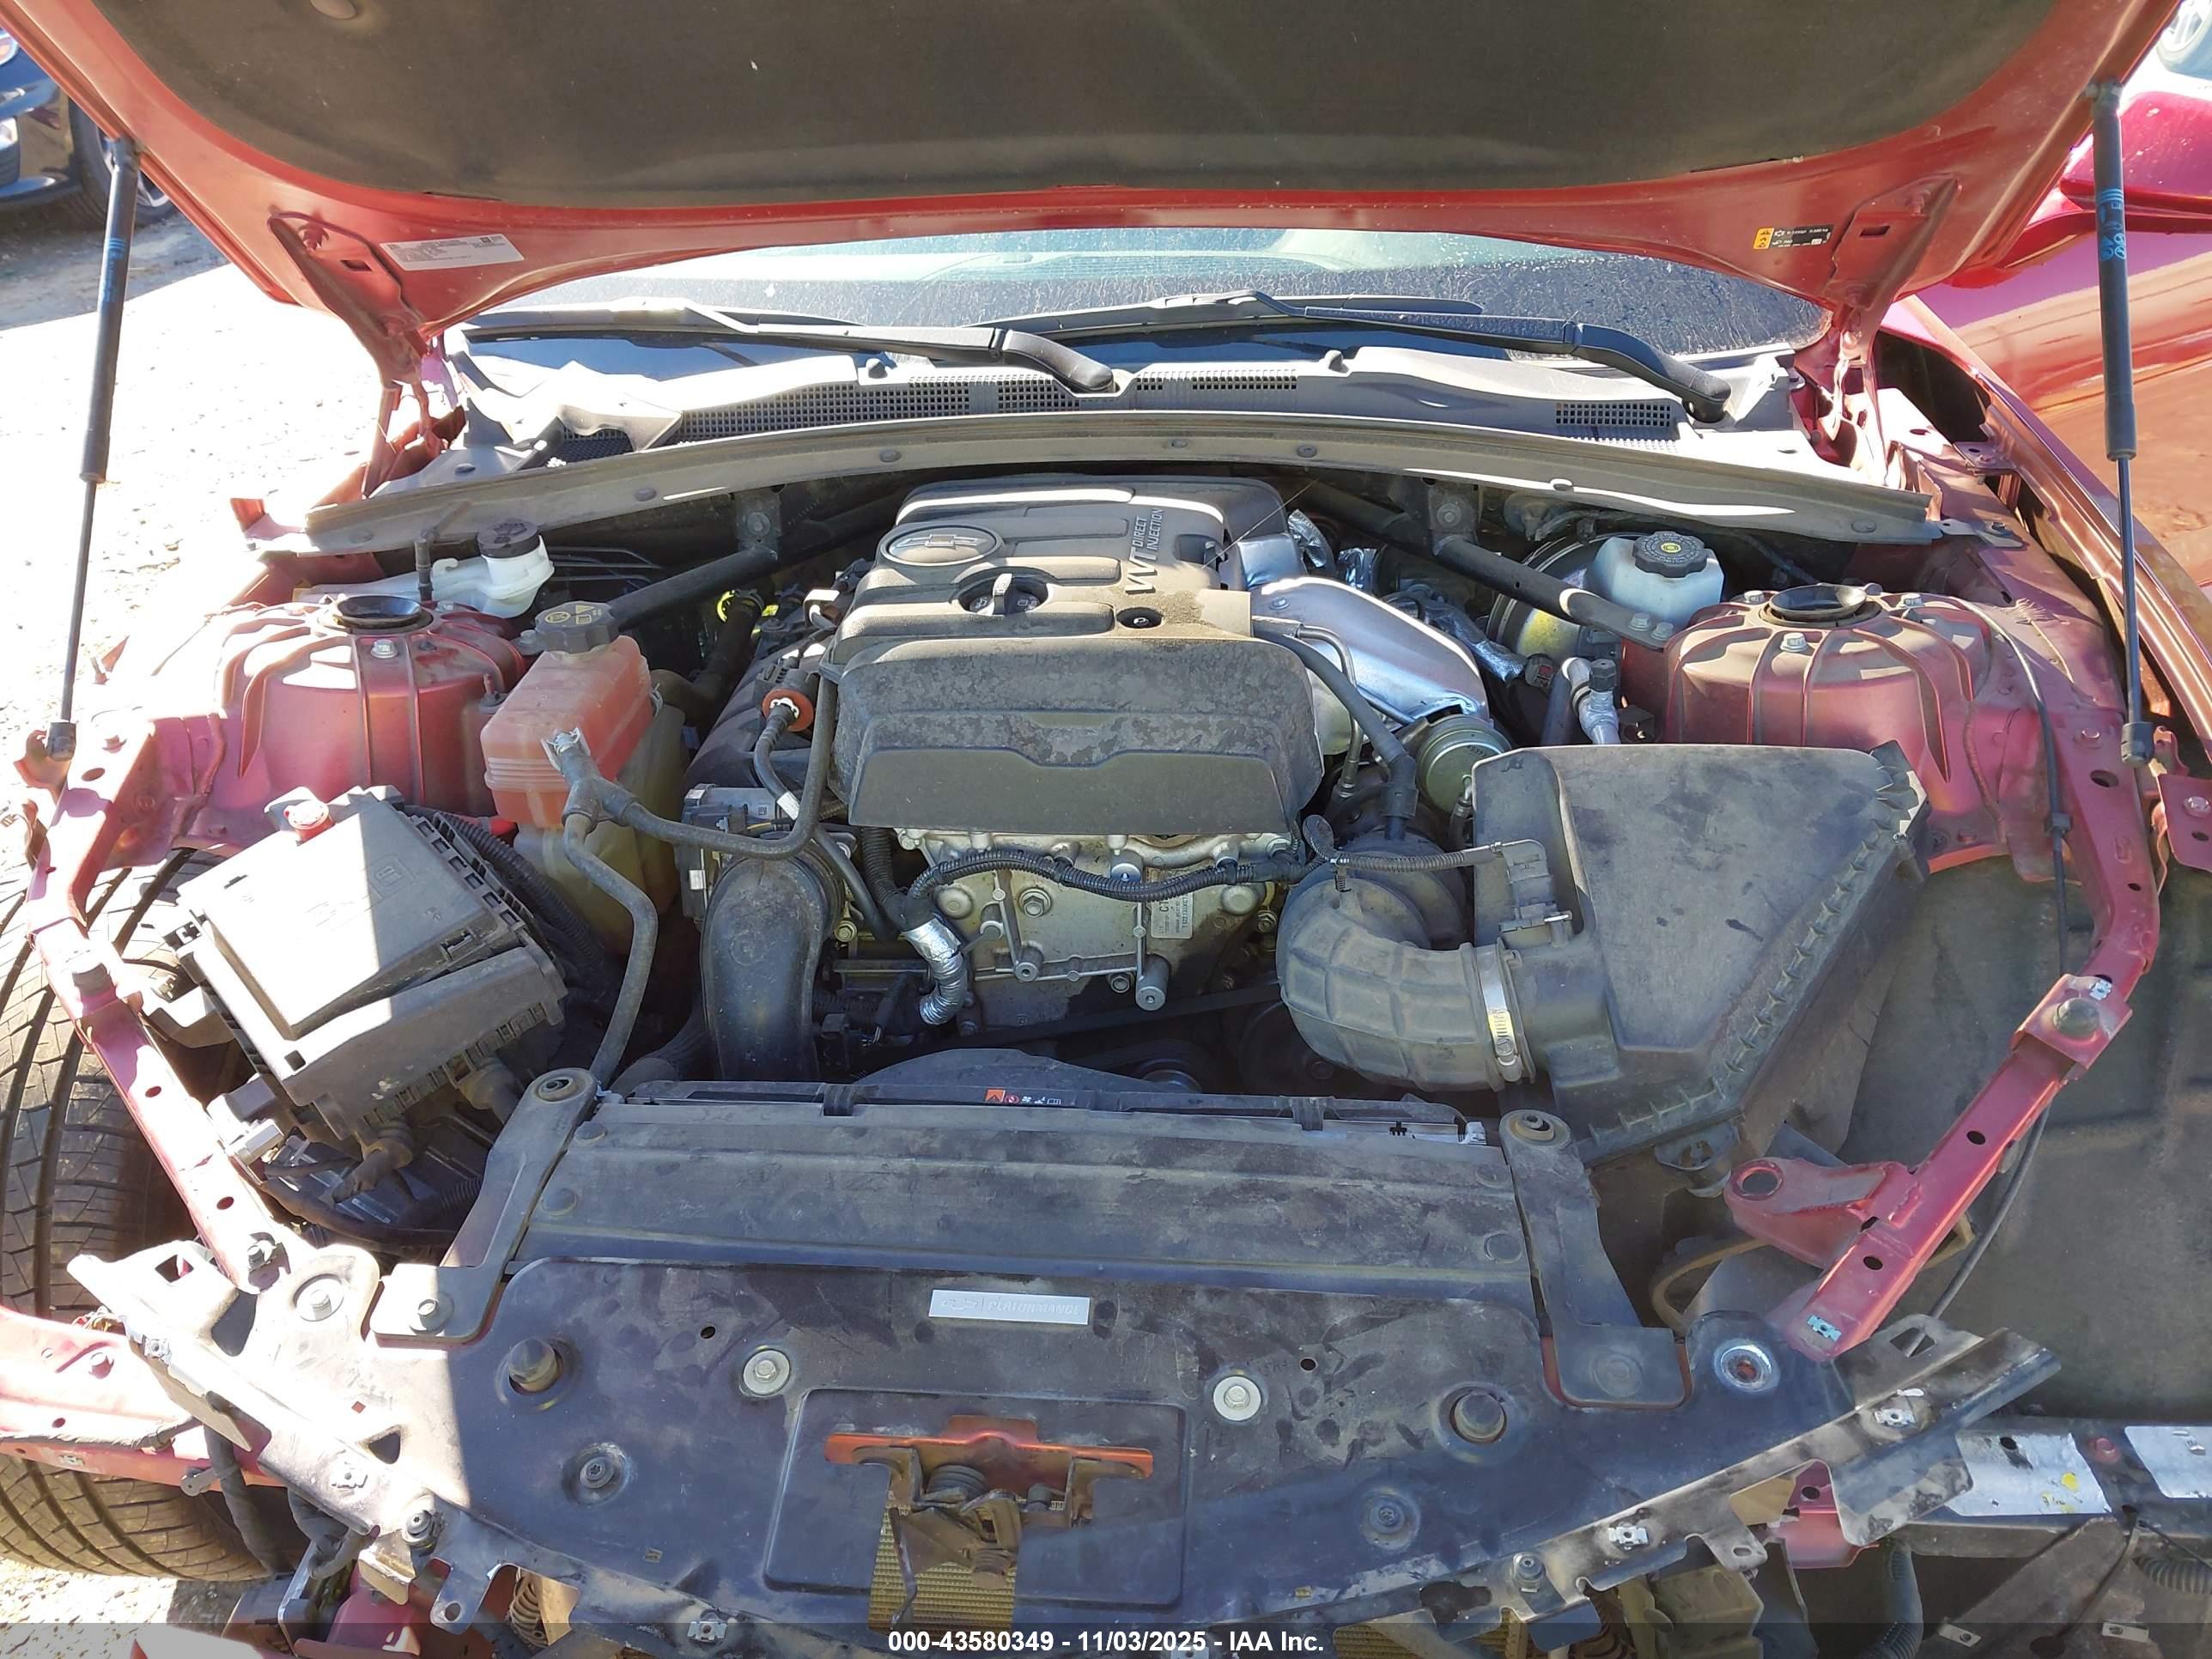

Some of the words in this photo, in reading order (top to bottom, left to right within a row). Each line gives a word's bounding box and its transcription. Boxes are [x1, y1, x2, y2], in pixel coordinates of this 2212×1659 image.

[1132, 516, 1148, 548] DIRECT
[1146, 507, 1164, 550] INJECTION
[1124, 547, 1157, 592] VVT
